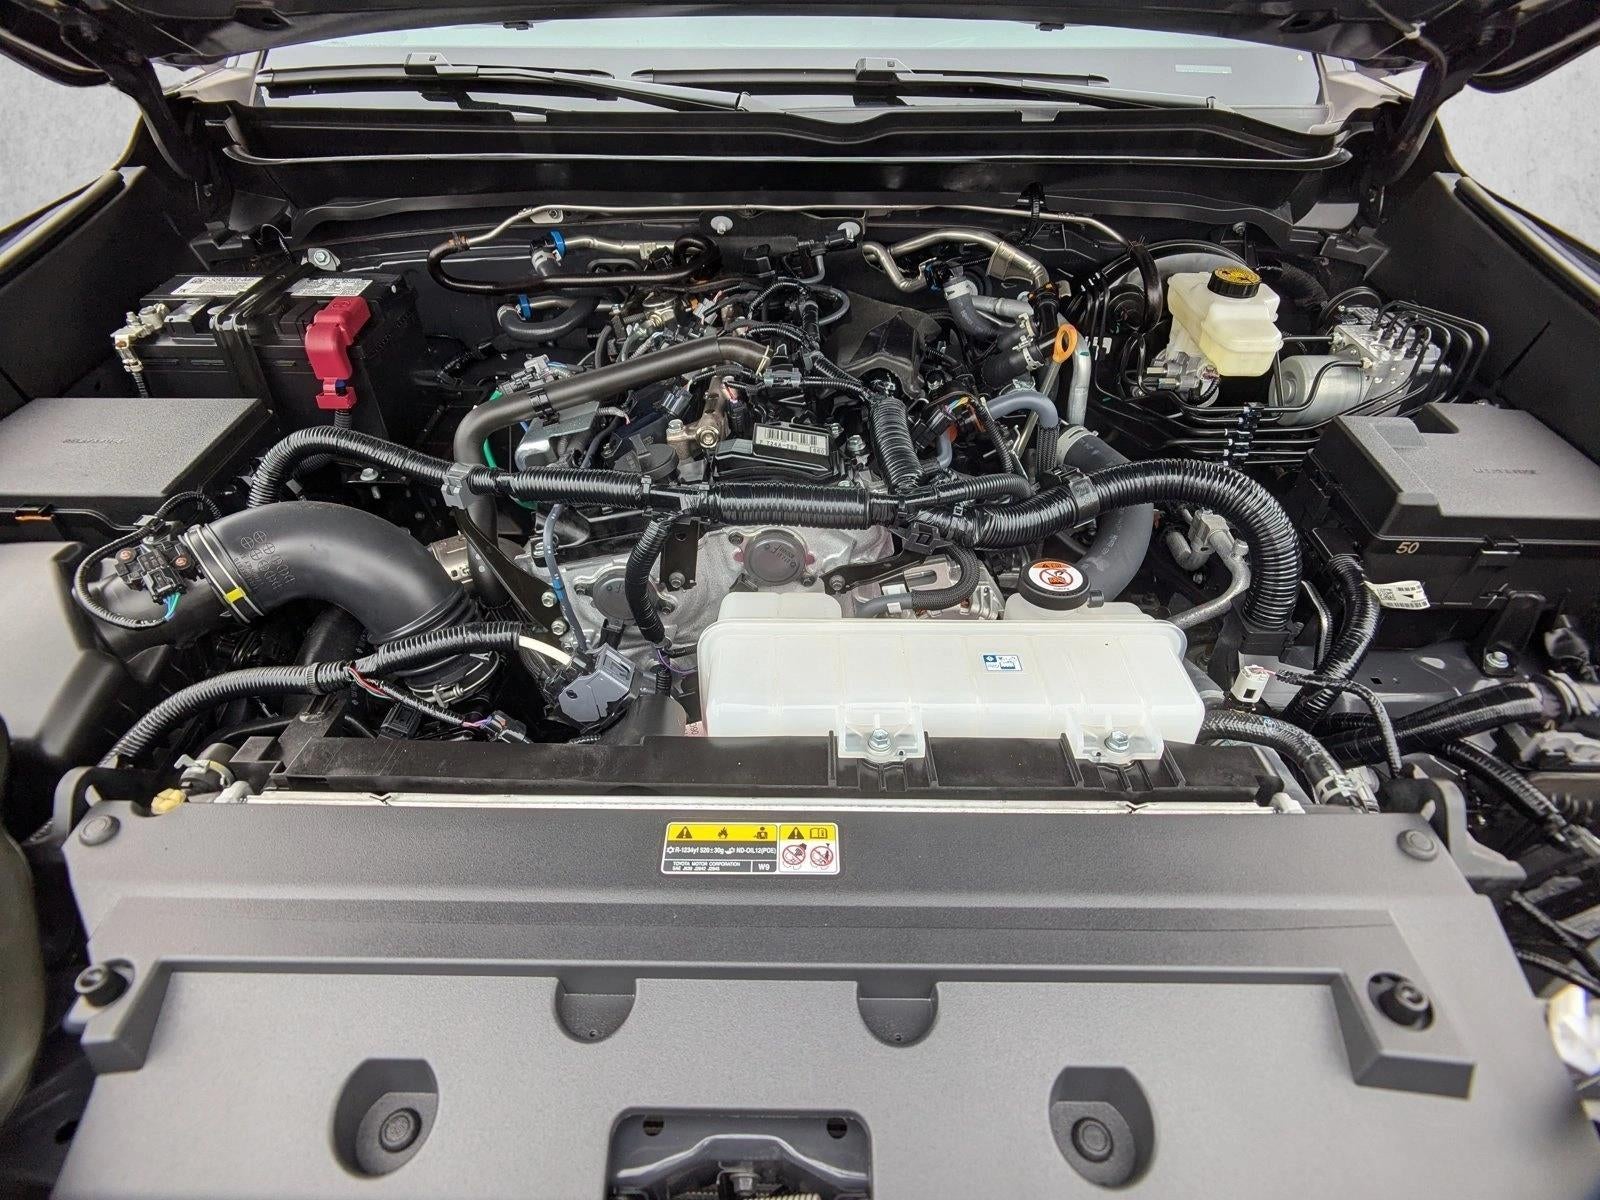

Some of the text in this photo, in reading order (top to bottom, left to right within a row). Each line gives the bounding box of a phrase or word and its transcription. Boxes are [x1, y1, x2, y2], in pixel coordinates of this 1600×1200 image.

[1395, 541, 1420, 554] 50
[674, 846, 699, 855] R-1234yf
[758, 863, 770, 871] W9
